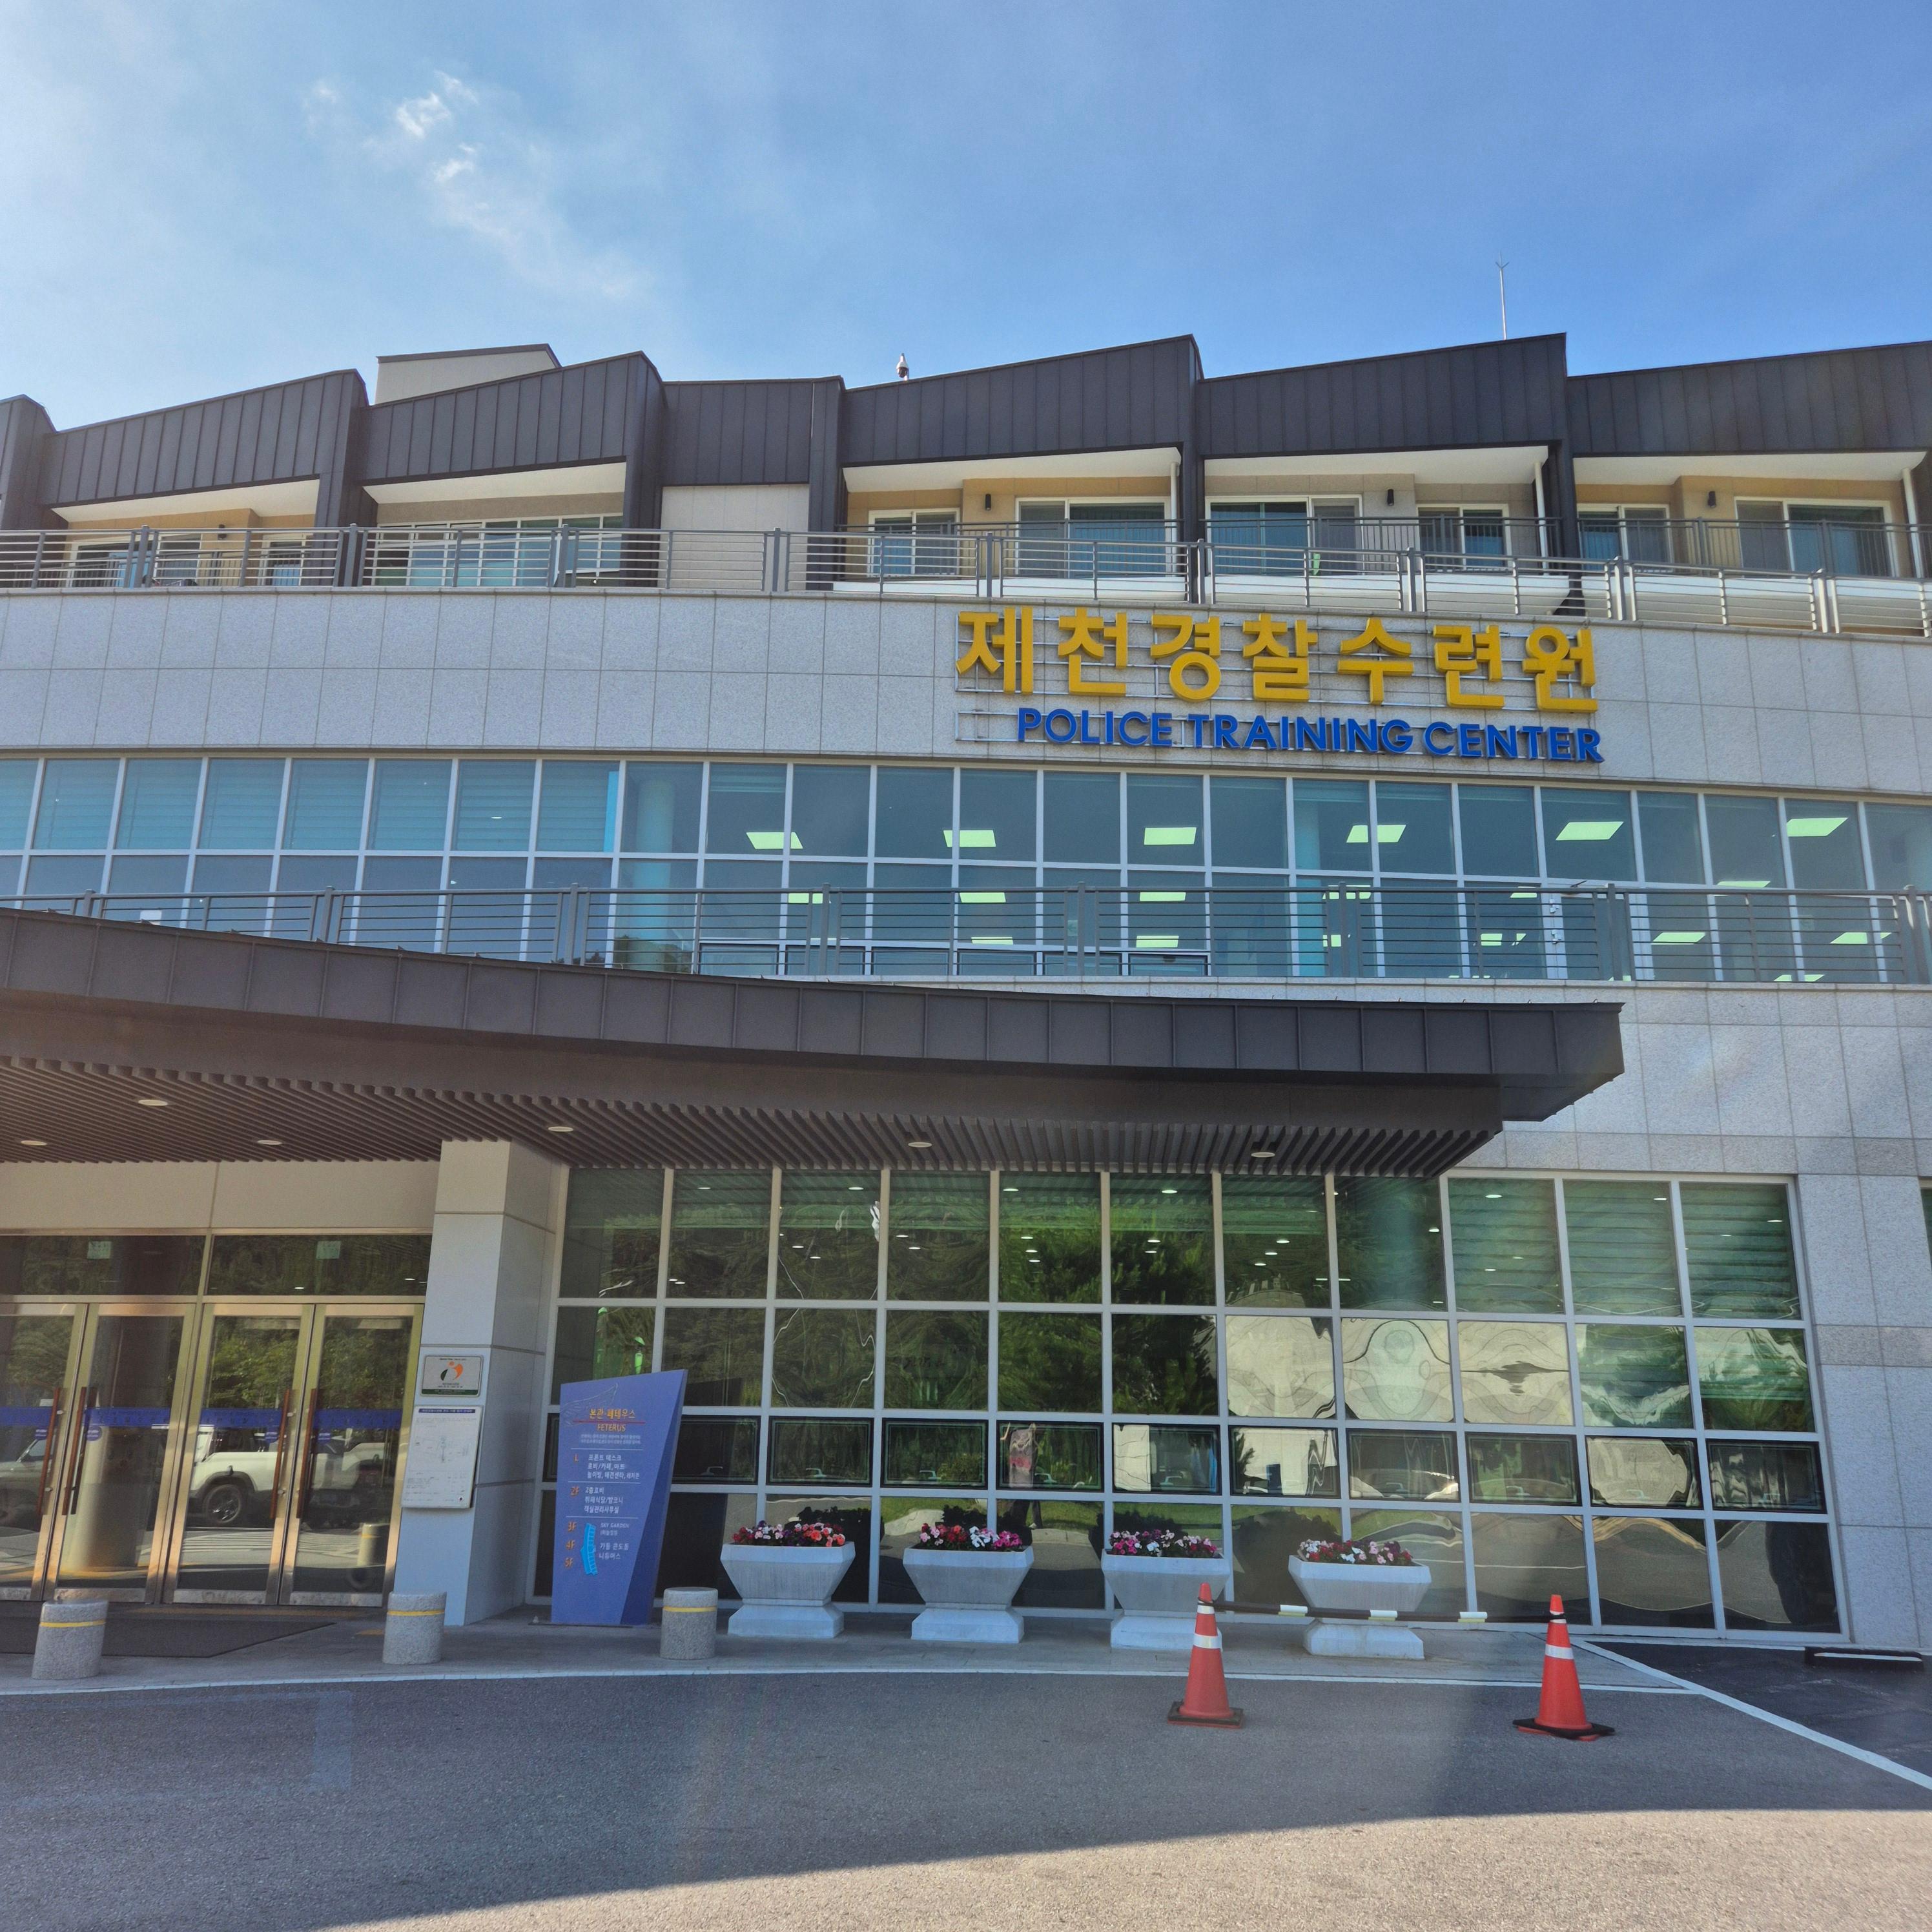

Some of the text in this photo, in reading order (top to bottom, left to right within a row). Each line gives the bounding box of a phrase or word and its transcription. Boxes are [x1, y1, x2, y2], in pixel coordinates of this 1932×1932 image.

[956, 606, 1599, 713] 제천경찰수련원
[1017, 707, 1605, 763] POLICE TRAINING CENTER
